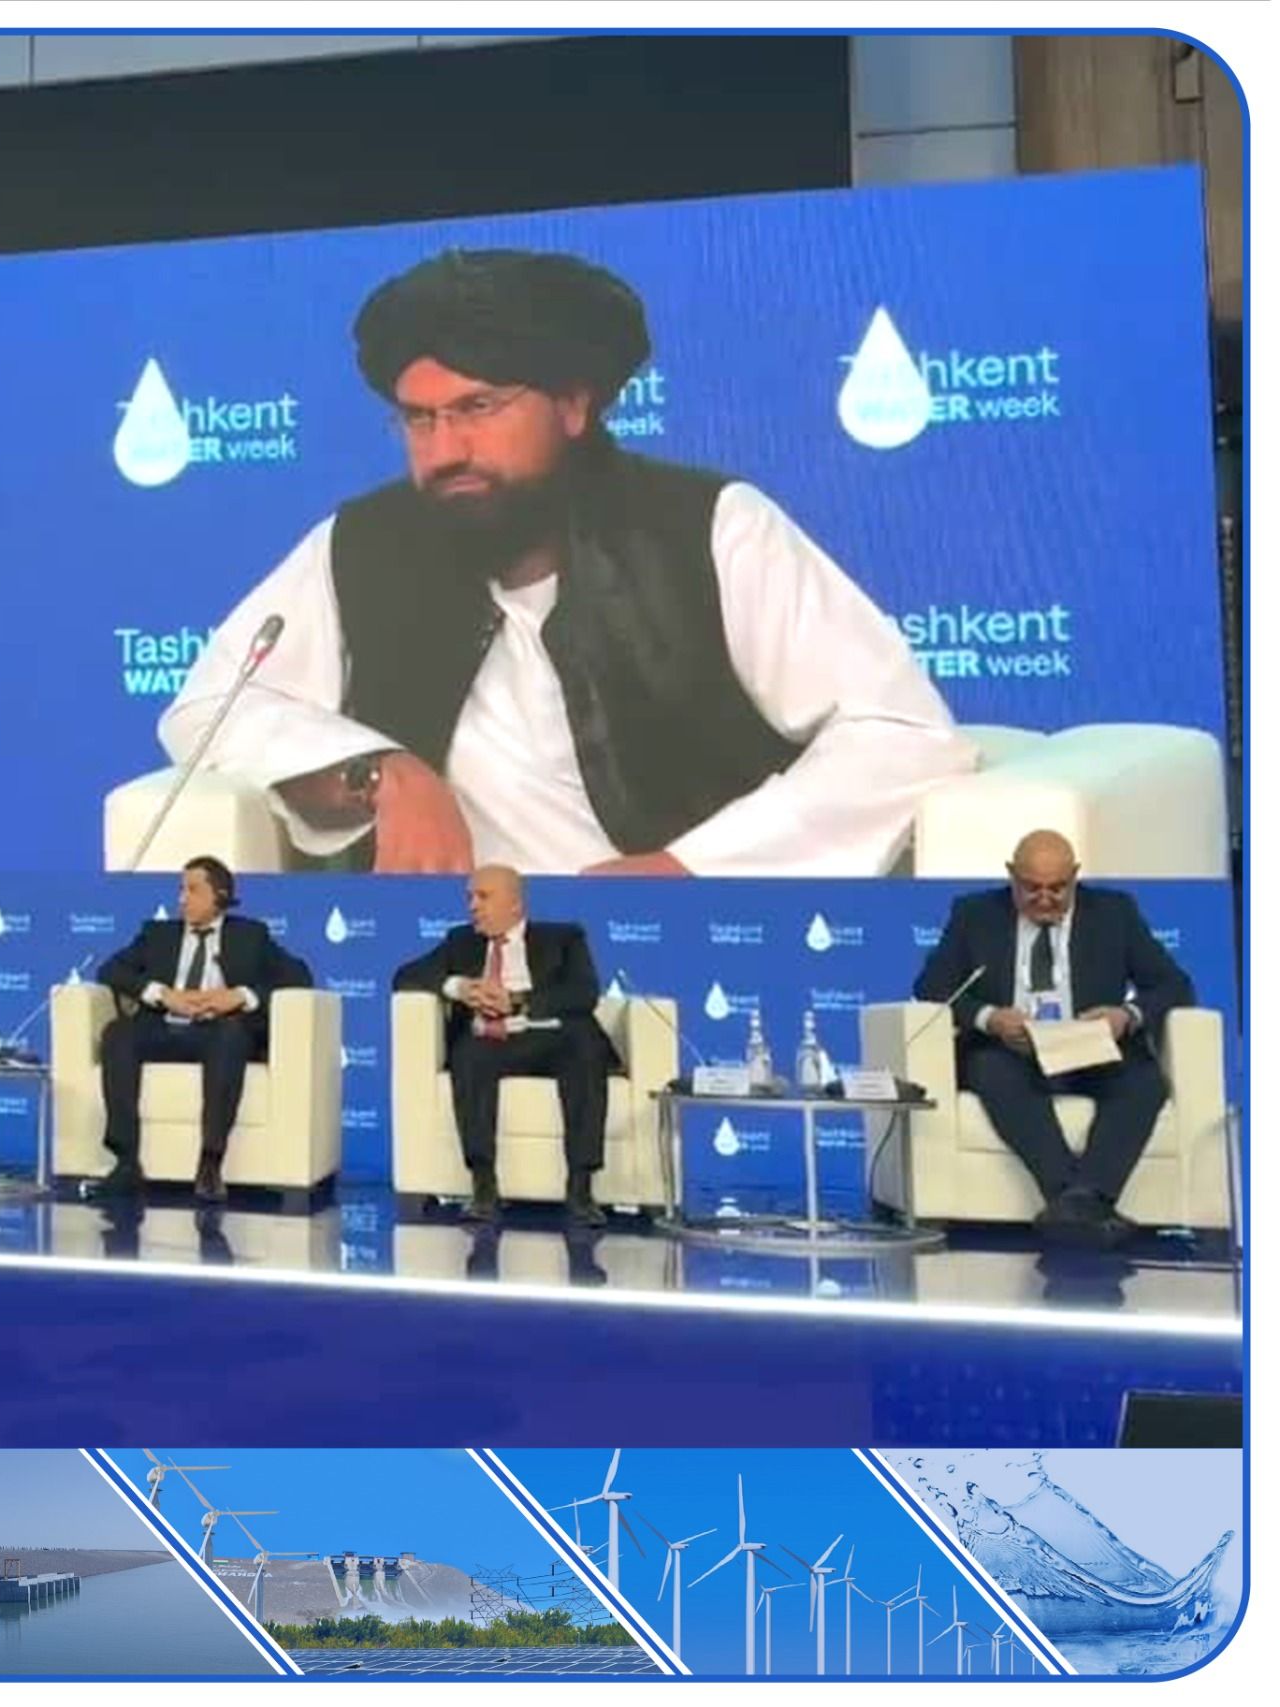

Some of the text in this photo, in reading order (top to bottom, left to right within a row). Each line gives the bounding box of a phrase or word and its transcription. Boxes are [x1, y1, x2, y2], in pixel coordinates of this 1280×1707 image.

[975, 388, 1061, 421] week
[226, 433, 297, 460] week
[915, 650, 1070, 677] TER week
[124, 668, 186, 695] WAT
